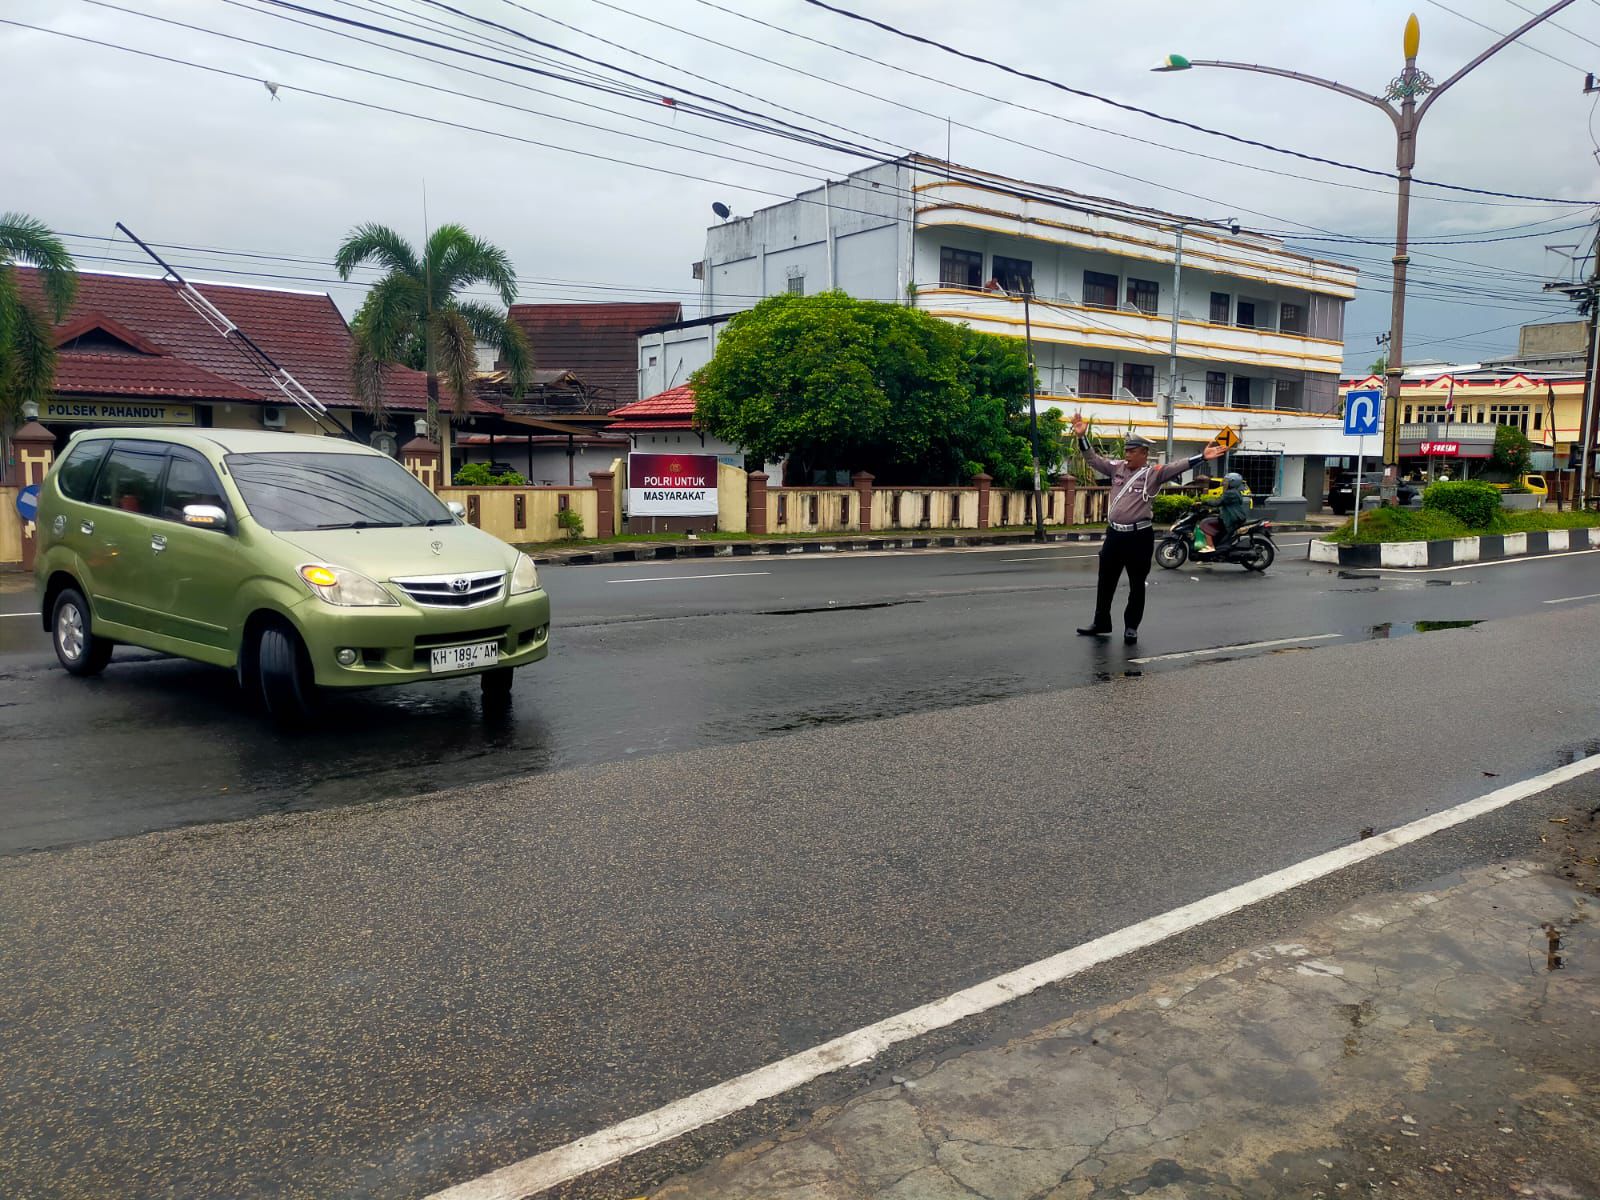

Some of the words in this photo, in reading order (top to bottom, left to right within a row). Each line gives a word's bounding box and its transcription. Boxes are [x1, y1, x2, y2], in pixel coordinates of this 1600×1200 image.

[48, 404, 97, 417] POLSEK
[101, 405, 166, 419] PAHANDUT
[644, 476, 672, 486] POLRI
[674, 476, 705, 487] UNTUK
[643, 491, 706, 501] MASYARAKAT
[432, 650, 447, 665] KH
[453, 646, 478, 662] 1894
[484, 643, 497, 658] AM
